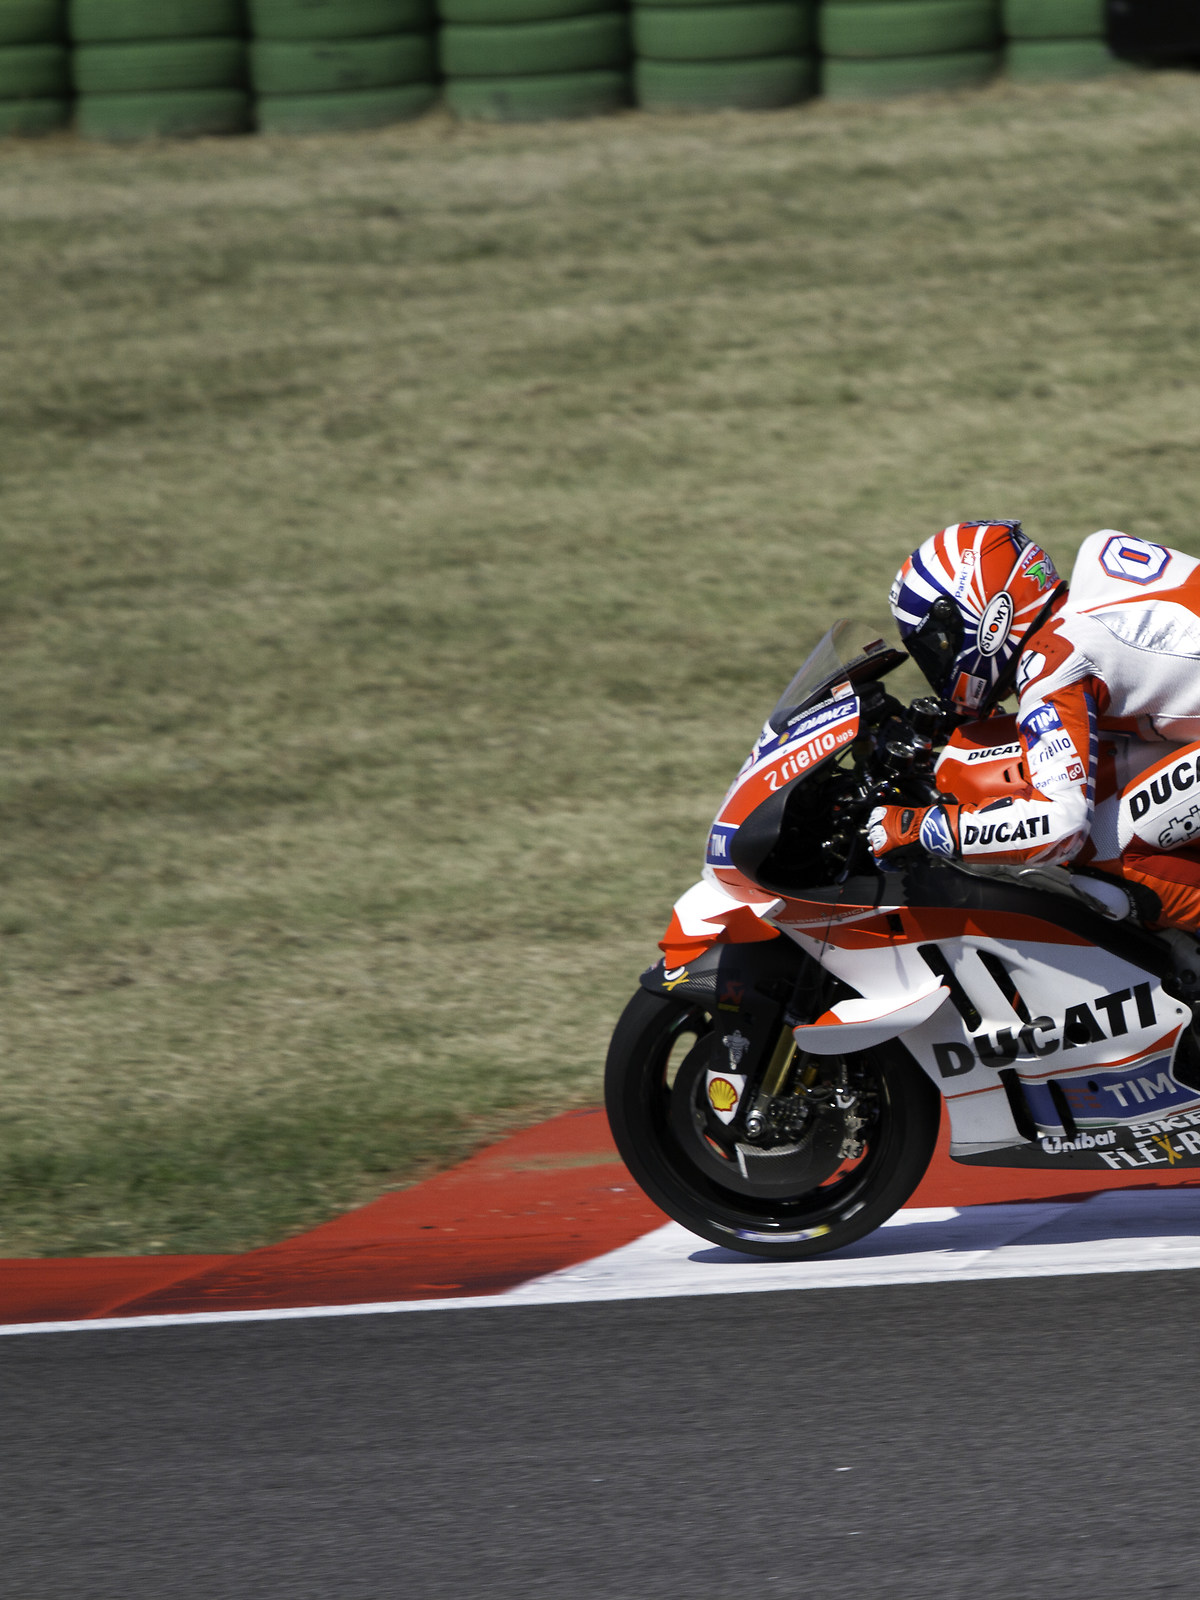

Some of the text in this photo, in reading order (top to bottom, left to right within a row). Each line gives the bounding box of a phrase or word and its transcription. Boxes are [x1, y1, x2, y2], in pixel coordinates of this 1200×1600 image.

[980, 601, 1010, 649] SUOMY
[1028, 707, 1060, 732] TIM
[781, 733, 836, 780] riello
[835, 729, 854, 744] ups
[967, 744, 1022, 761] DUCAT
[1039, 737, 1071, 762] riello
[963, 815, 1050, 846] DUCATI
[711, 834, 727, 858] TIM
[932, 981, 1157, 1078] DUCATI
[1103, 1072, 1178, 1108] TIM
[1041, 1130, 1117, 1154] Unibat
